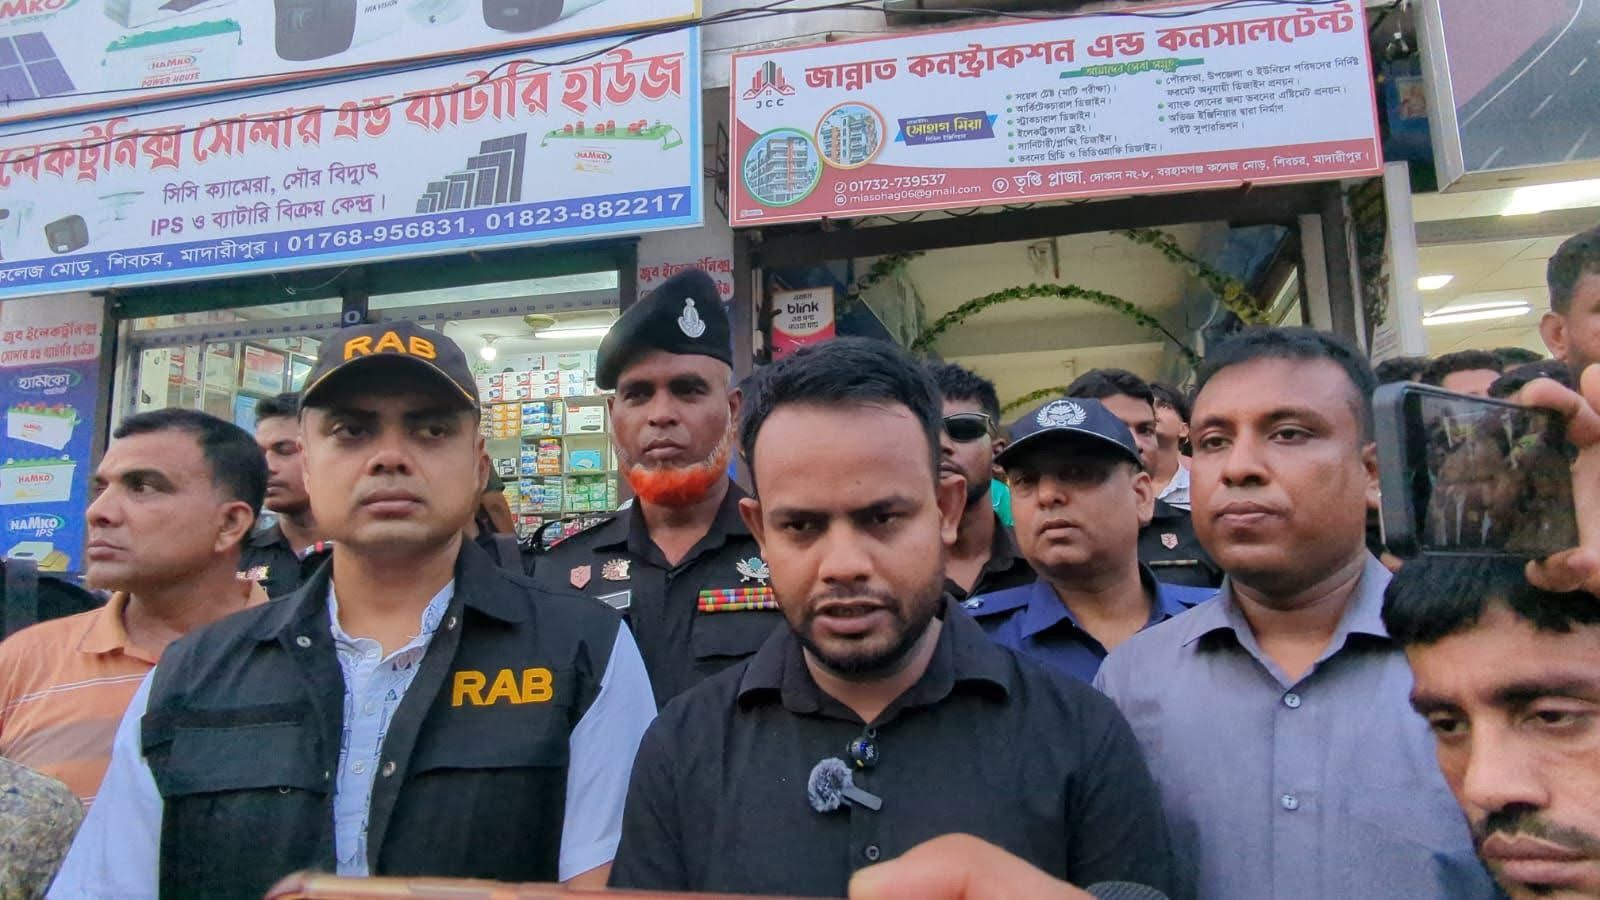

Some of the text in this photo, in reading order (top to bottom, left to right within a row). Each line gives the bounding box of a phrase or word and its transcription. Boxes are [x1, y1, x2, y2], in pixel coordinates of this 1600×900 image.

[805, 3, 1353, 91] জান্নাত কনস্ট্রাকশন এন্ড কনসালটেন্ট
[193, 104, 325, 163] সোলার
[335, 96, 395, 142] এন্ড
[403, 59, 552, 133] ব্যাটারি
[560, 49, 685, 114] হাউজ
[163, 162, 378, 204] সিসি ক্যামেরা, সৌর বিদ্যুৎ
[849, 173, 946, 192] 01732-739537
[151, 217, 183, 237] IPS
[192, 215, 205, 229] ও
[212, 202, 270, 229] ব্যাটারি
[276, 199, 325, 221] বিক্রয়
[288, 217, 476, 252] 01768-956831,
[486, 193, 684, 231] 01823-882217
[787, 301, 819, 314] blink
[344, 331, 438, 361] RAB
[18, 474, 50, 484] HAMKO
[10, 516, 58, 530] HAMKO
[35, 528, 54, 537] IPS
[451, 667, 554, 707] RAB
